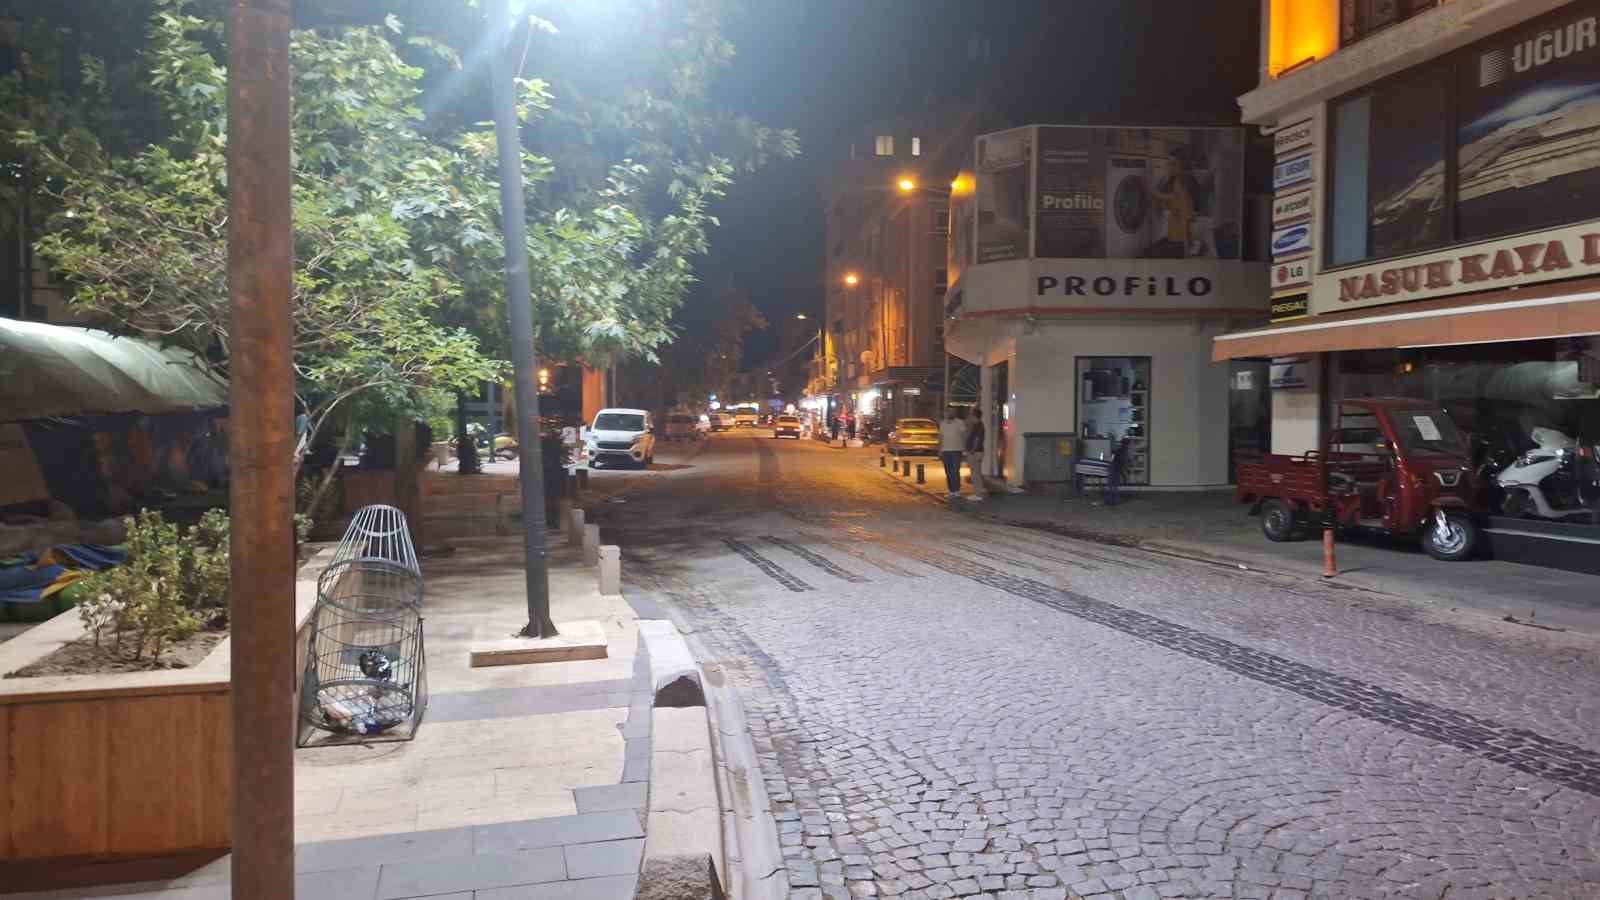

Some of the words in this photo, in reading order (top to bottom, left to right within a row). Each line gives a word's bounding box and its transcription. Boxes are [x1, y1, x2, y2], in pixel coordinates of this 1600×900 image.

[1043, 194, 1104, 209] Profilo
[1290, 266, 1304, 279] LG
[1338, 260, 1454, 302] NASUH
[1458, 240, 1573, 283] KAYA
